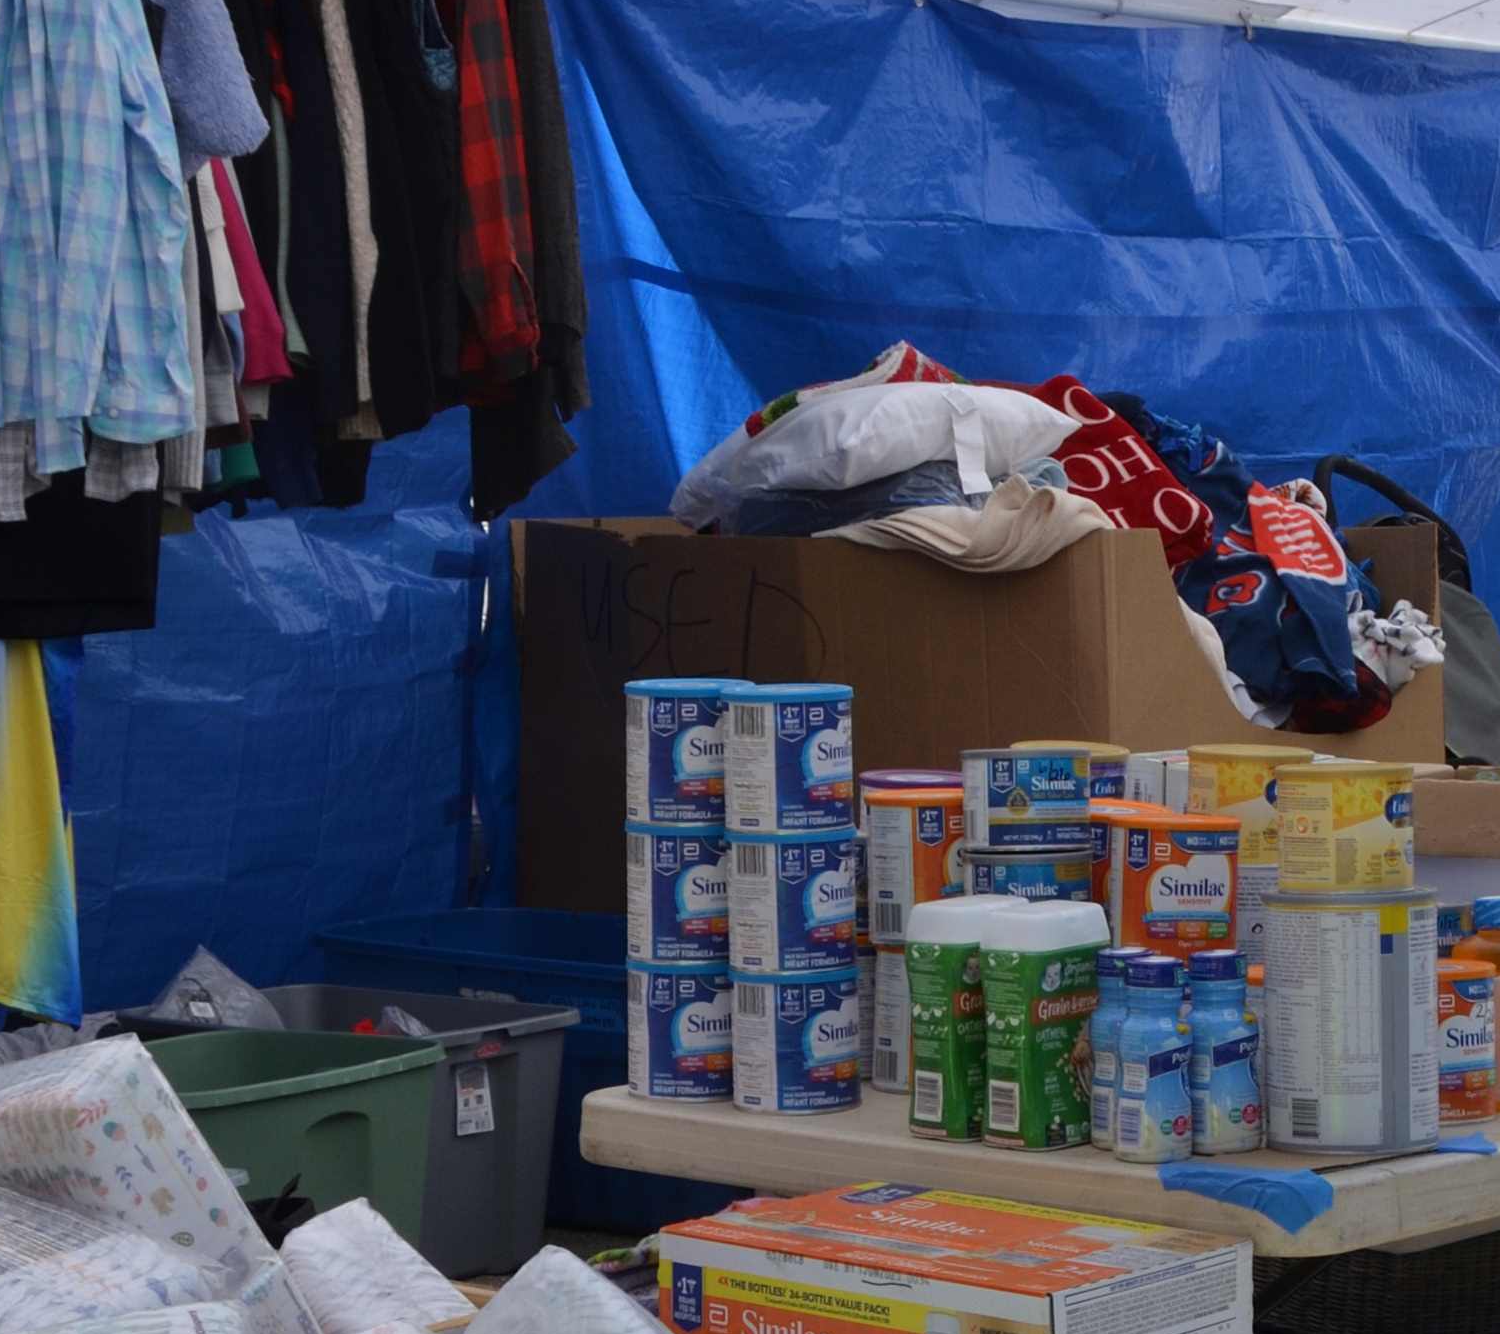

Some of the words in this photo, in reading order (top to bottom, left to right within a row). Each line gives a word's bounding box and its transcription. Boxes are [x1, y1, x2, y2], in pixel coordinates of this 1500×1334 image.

[581, 563, 827, 679] USED
[1007, 882, 1060, 897] Similac
[1159, 875, 1226, 898] Similac
[835, 1297, 863, 1311] VALUE
[864, 1303, 891, 1317] PACK!
